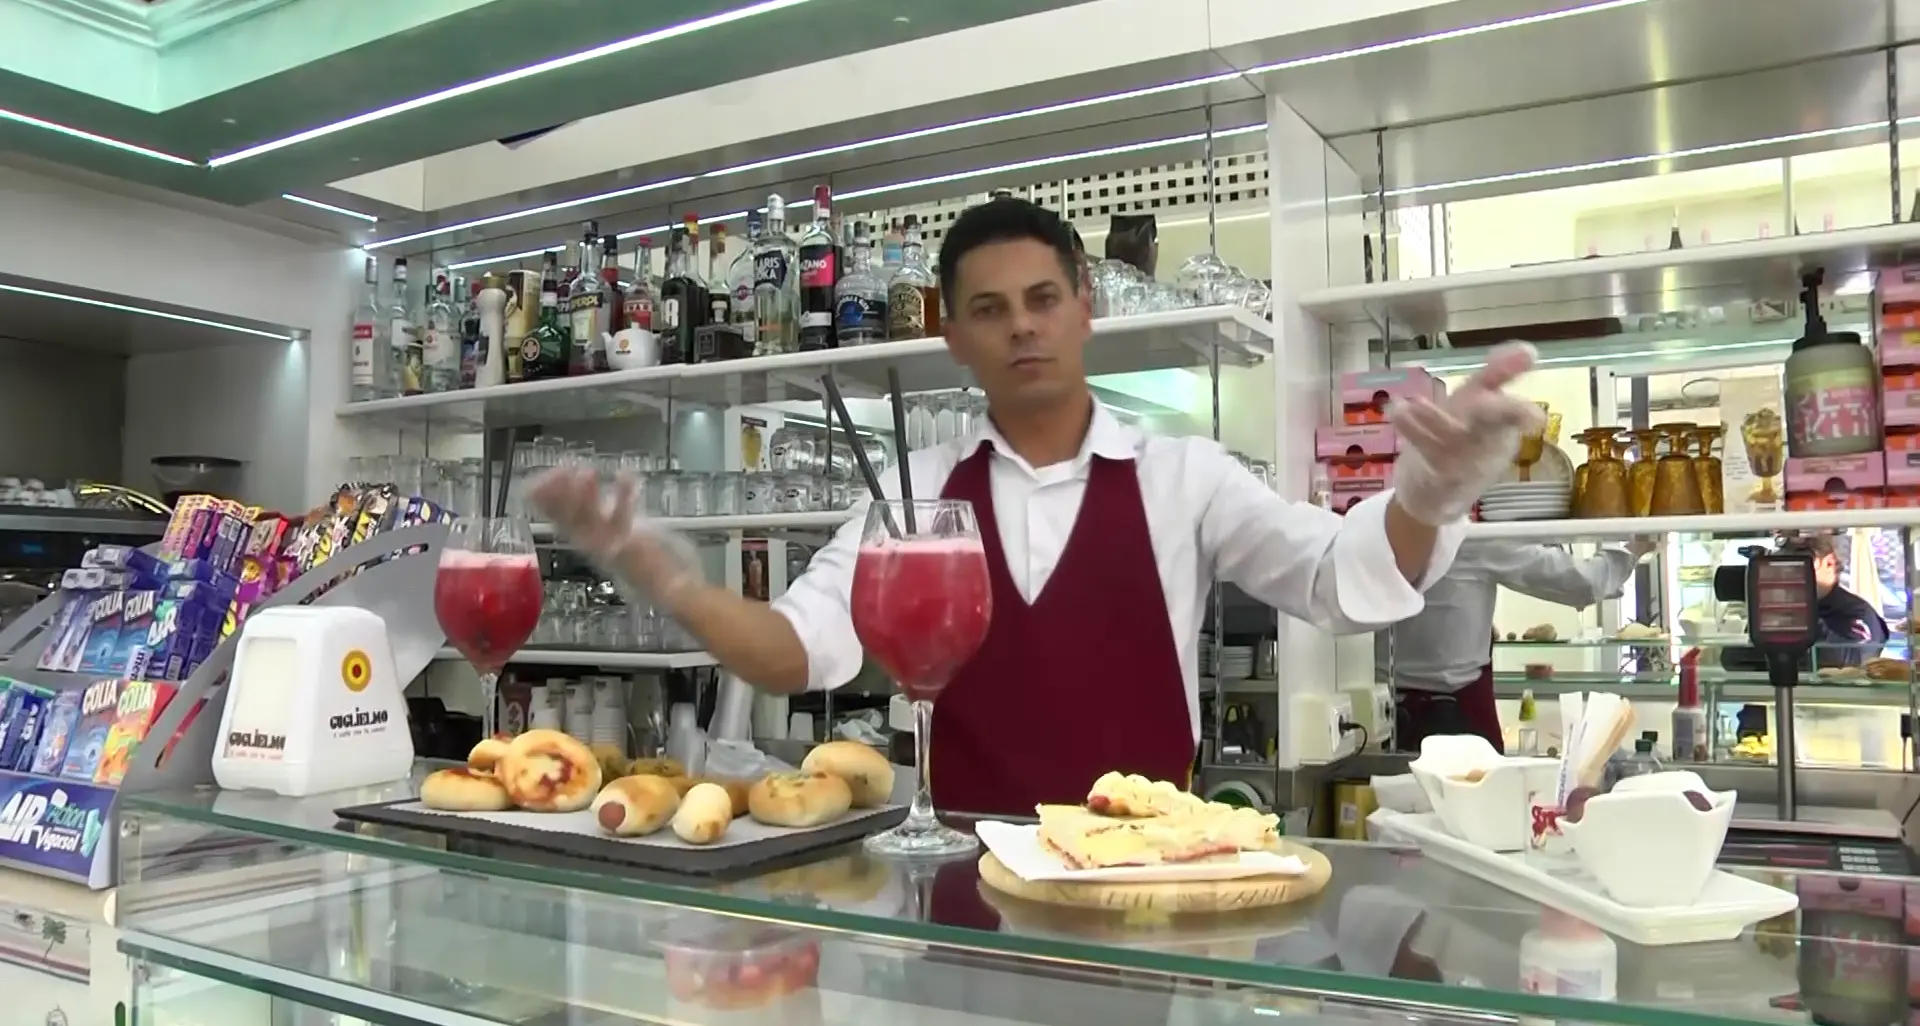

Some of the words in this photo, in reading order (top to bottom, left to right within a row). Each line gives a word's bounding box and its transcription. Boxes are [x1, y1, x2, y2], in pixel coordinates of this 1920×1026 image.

[124, 591, 154, 622] GOLIA
[146, 606, 176, 646] AIR
[83, 680, 117, 714] GOLIA
[118, 682, 153, 715] GOLIA
[330, 707, 389, 729] GUGLIELMO
[0, 791, 48, 845] AIR
